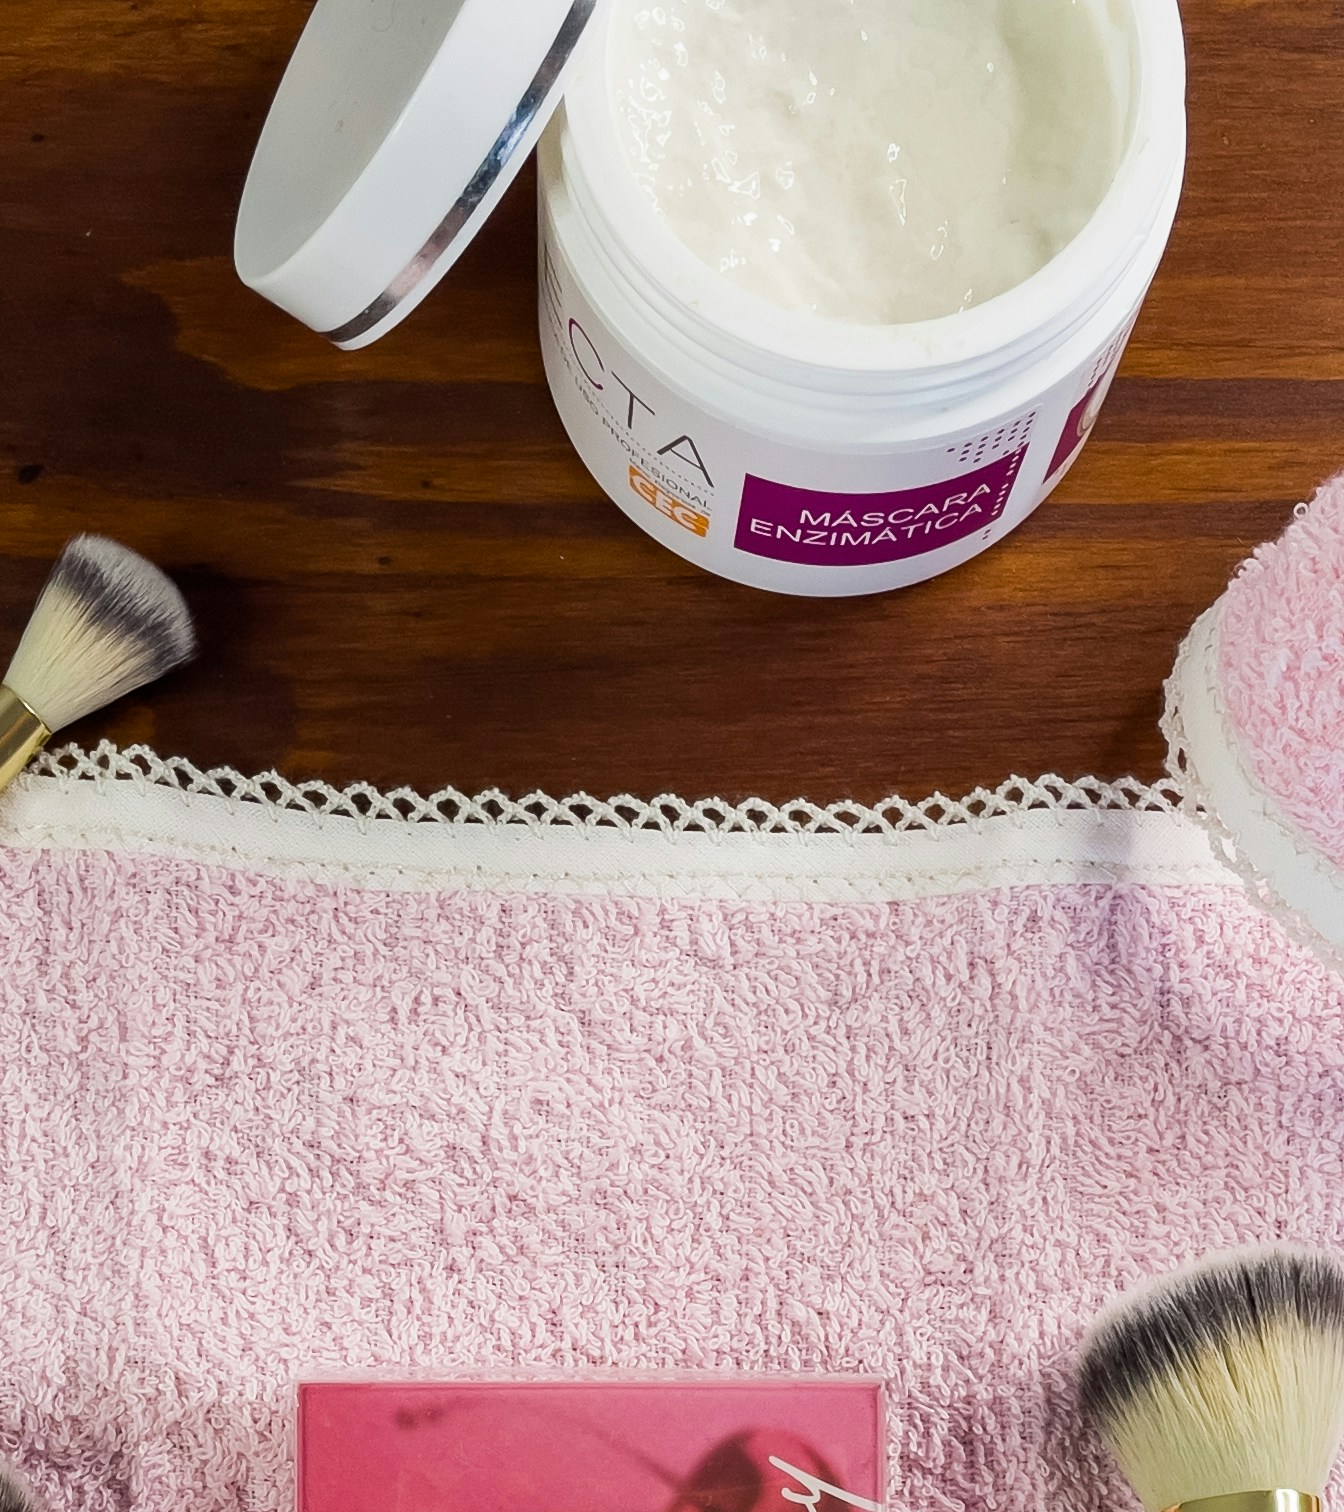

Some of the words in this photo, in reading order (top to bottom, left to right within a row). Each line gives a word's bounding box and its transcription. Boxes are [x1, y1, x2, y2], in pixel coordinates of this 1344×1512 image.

[602, 416, 713, 511] PROFESIONAL
[750, 503, 982, 546] ENZIMÁTICA
[800, 483, 990, 527] MÁSCARA
